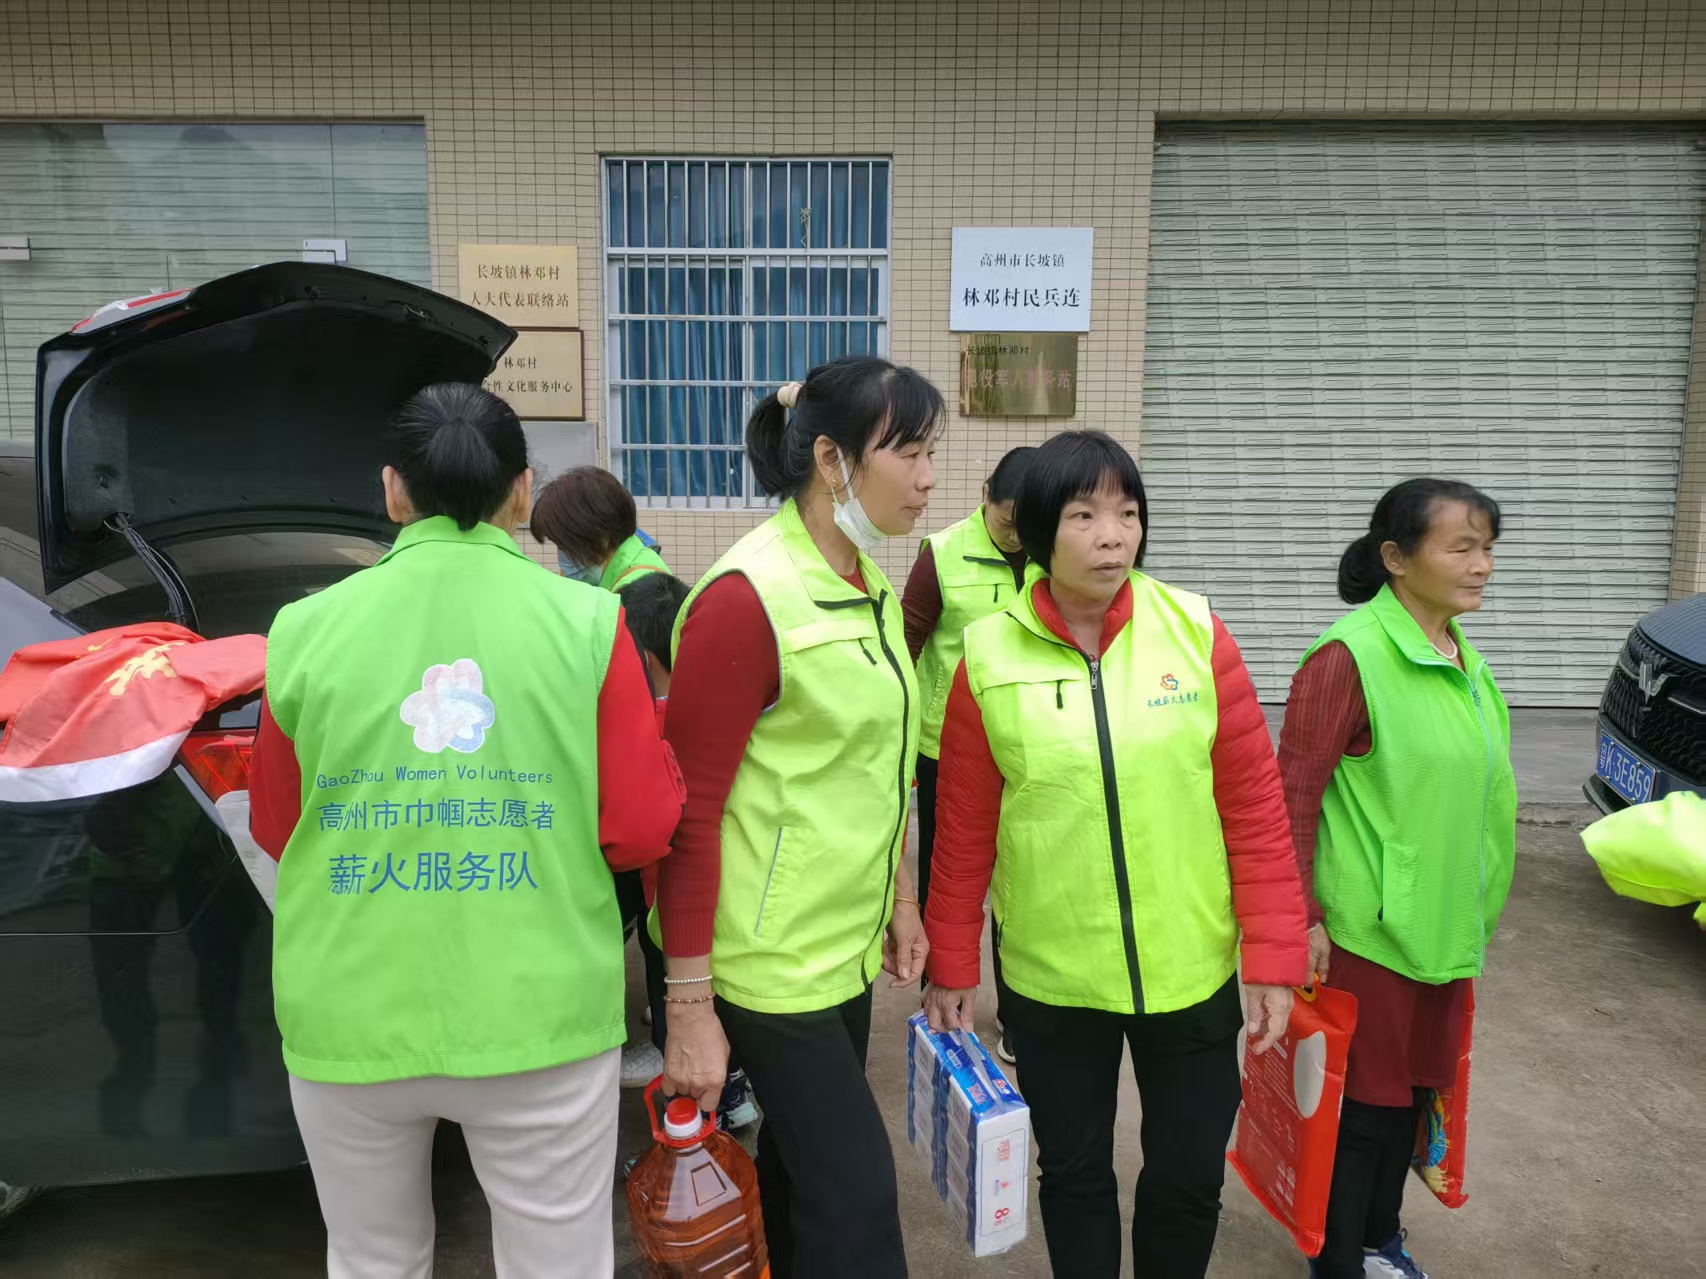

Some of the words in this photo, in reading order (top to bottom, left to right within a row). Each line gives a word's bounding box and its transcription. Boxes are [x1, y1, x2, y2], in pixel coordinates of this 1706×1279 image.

[980, 253, 1065, 268] 高州市长坡镇
[477, 264, 561, 281] 长坡镇林邓村
[471, 291, 569, 308] 人大代表联络站
[963, 287, 1080, 308] 林邓村民兵连
[504, 357, 537, 370] 林邓村
[317, 769, 384, 789] GaoZhou
[396, 766, 447, 781] Women
[456, 765, 553, 784] Volunteers
[316, 797, 555, 831] 高州市巾帼志愿者
[328, 851, 539, 895] 薪火服务队
